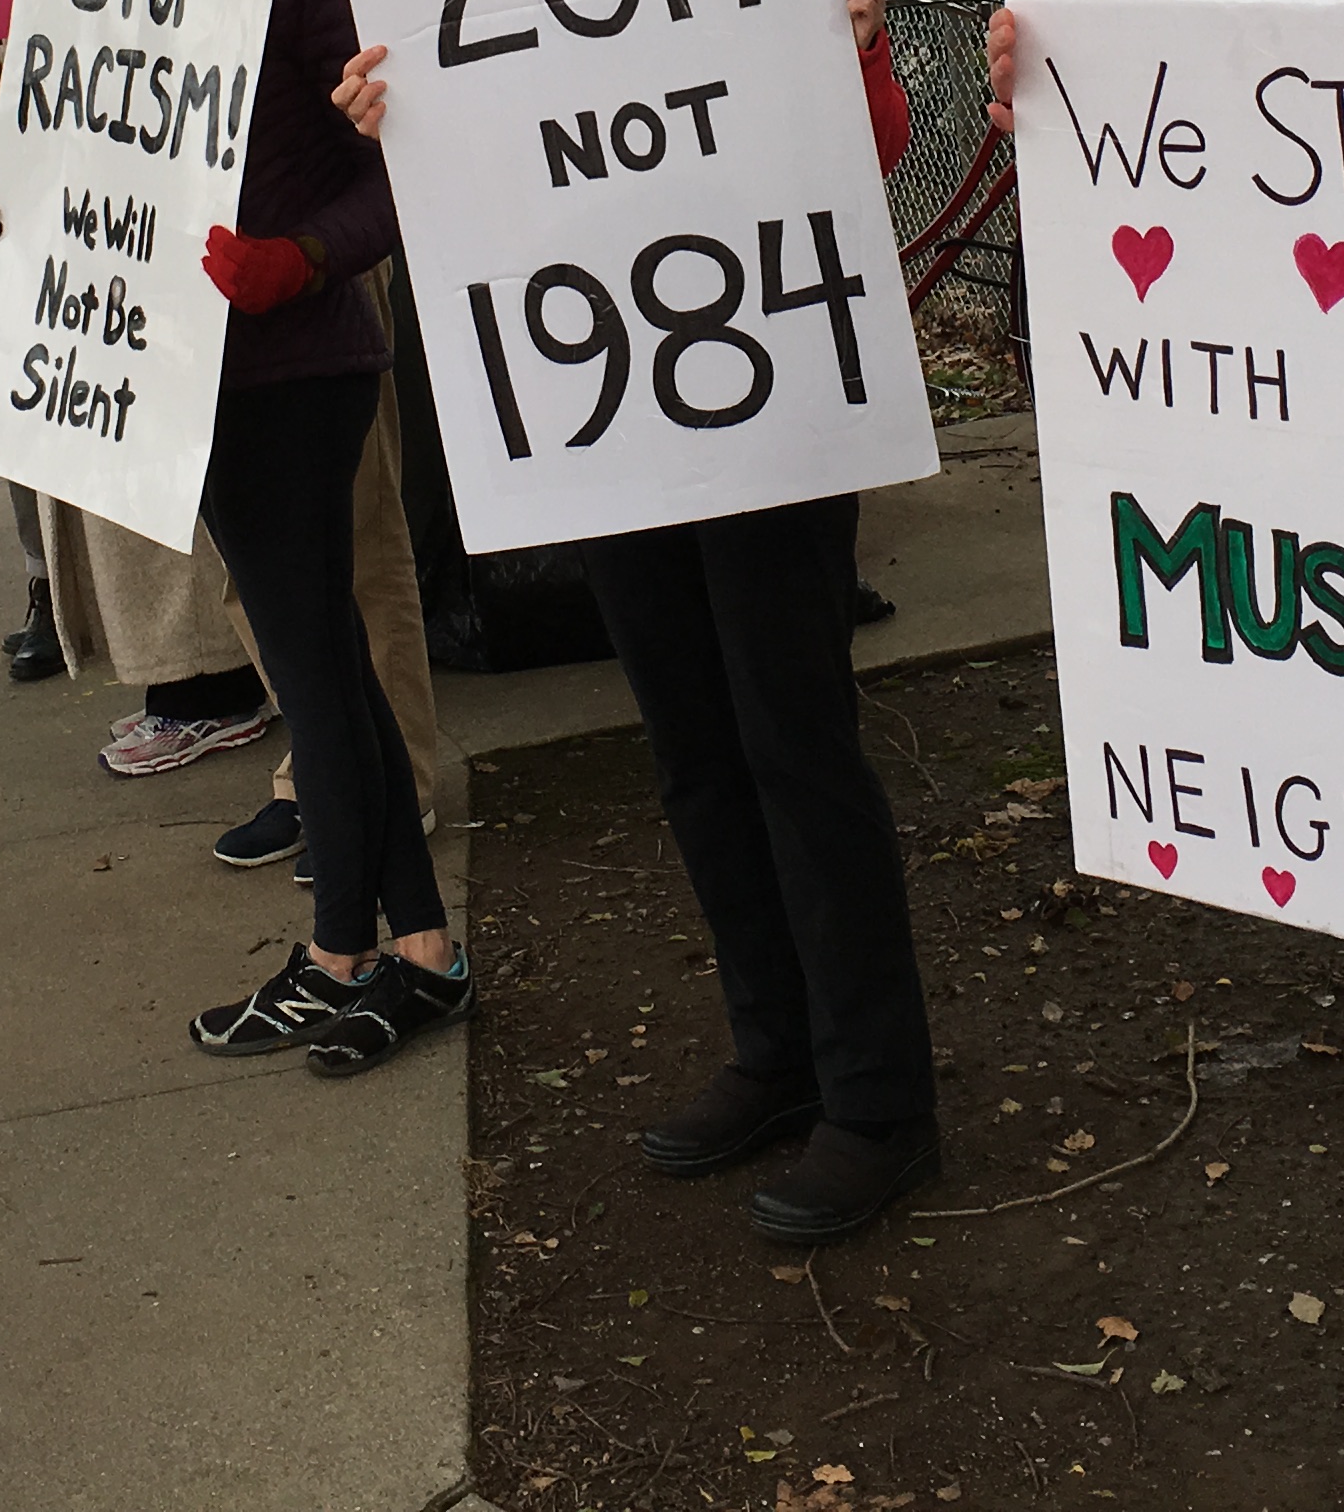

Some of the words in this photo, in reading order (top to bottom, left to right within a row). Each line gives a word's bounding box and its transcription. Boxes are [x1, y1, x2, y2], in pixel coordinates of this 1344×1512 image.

[17, 34, 248, 171] RACISM!
[539, 80, 729, 188] NOT
[1044, 57, 1207, 190] We
[63, 186, 98, 251] We
[104, 195, 156, 263] Will
[35, 255, 100, 336] Not
[104, 275, 147, 351] Be
[467, 210, 866, 462] 1984
[10, 343, 136, 442] Silent
[1078, 331, 1290, 422] WITH
